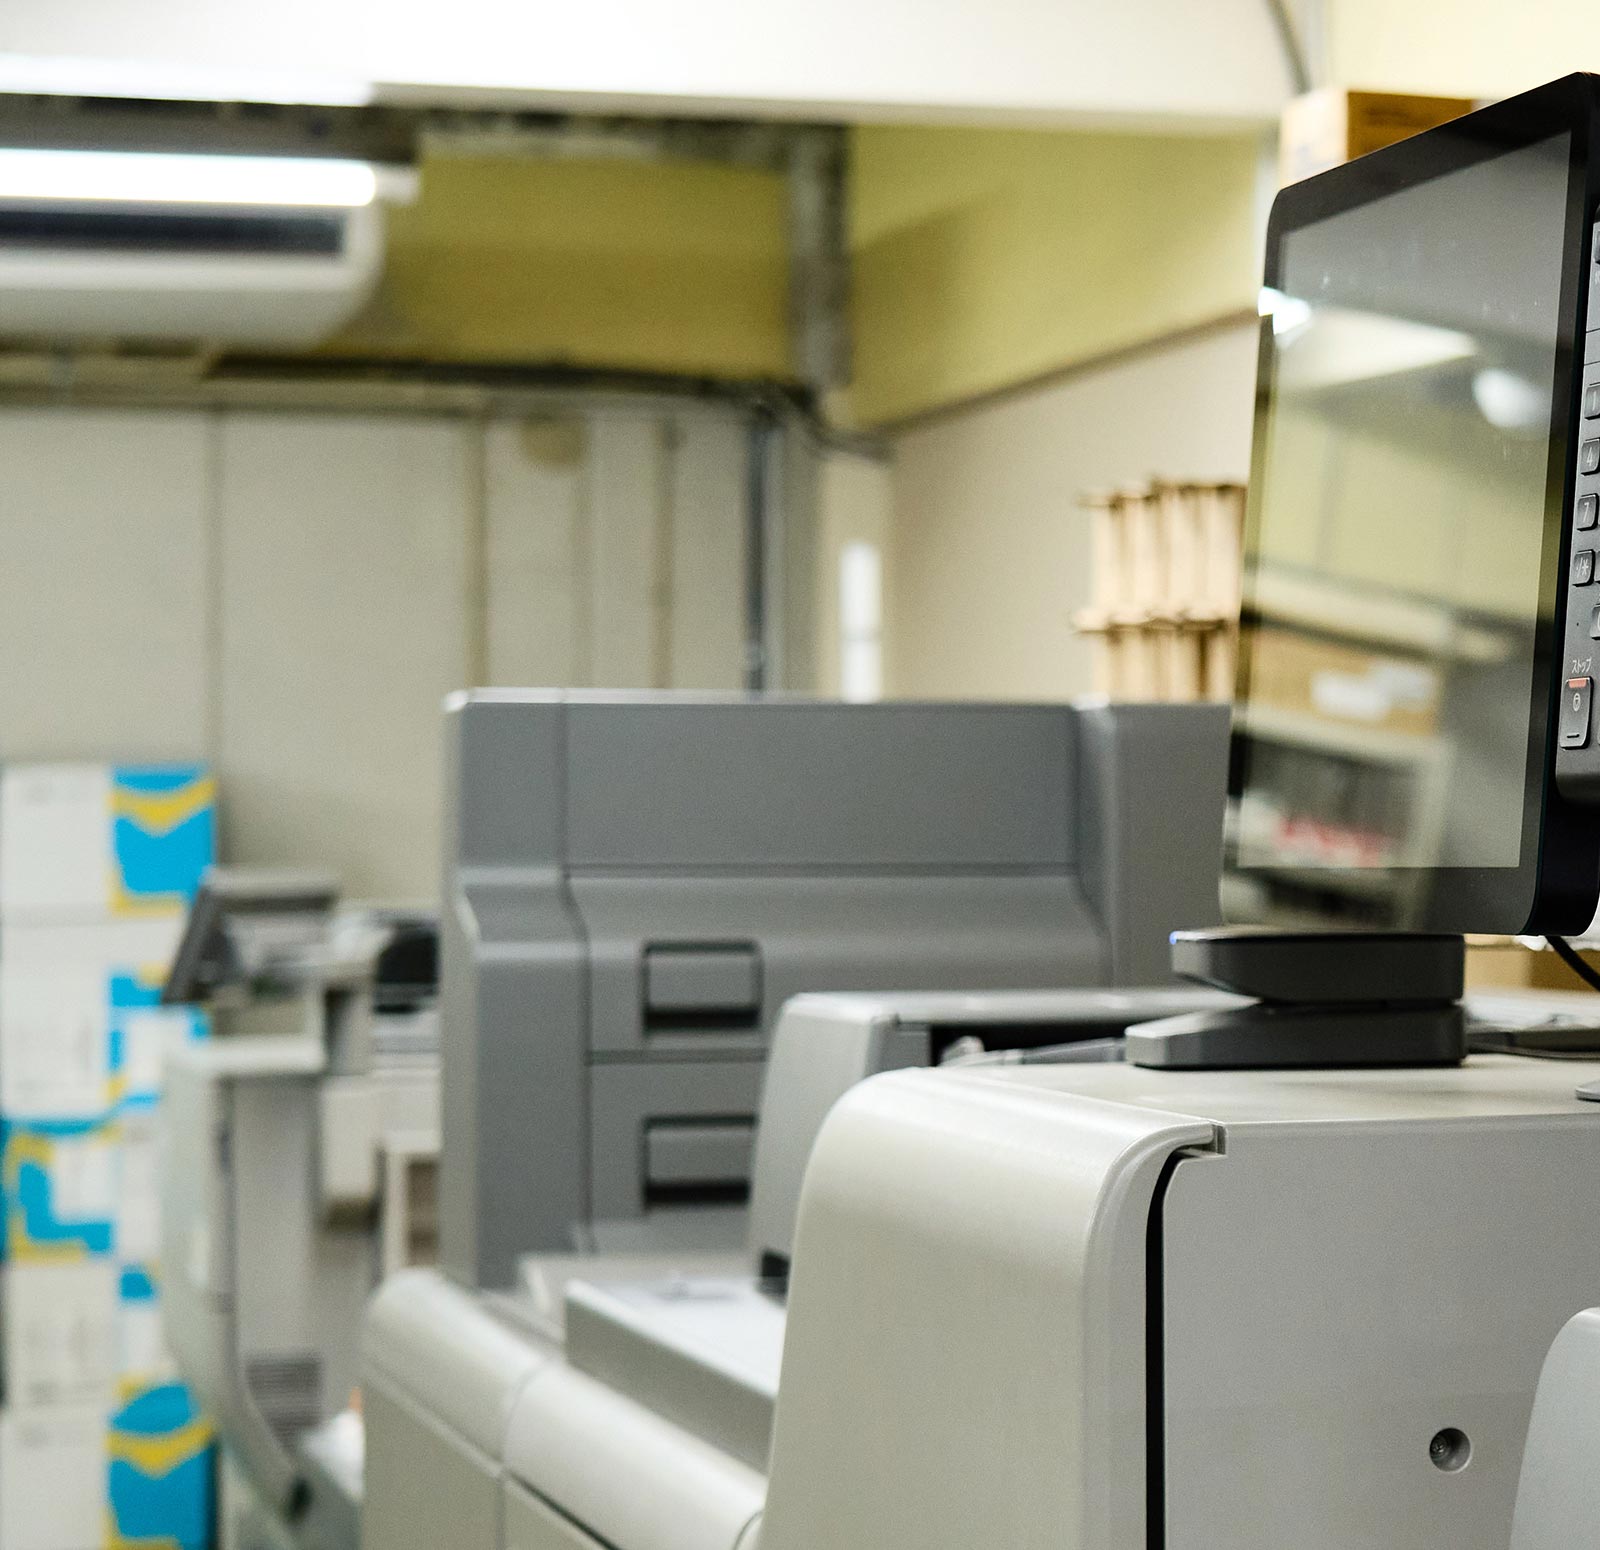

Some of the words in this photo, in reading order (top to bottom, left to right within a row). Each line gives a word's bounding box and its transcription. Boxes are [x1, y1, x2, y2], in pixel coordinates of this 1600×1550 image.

[1591, 391, 1598, 410] 1
[1585, 445, 1594, 465] 4
[1583, 502, 1590, 521] 7
[1571, 657, 1592, 673] ストップ
